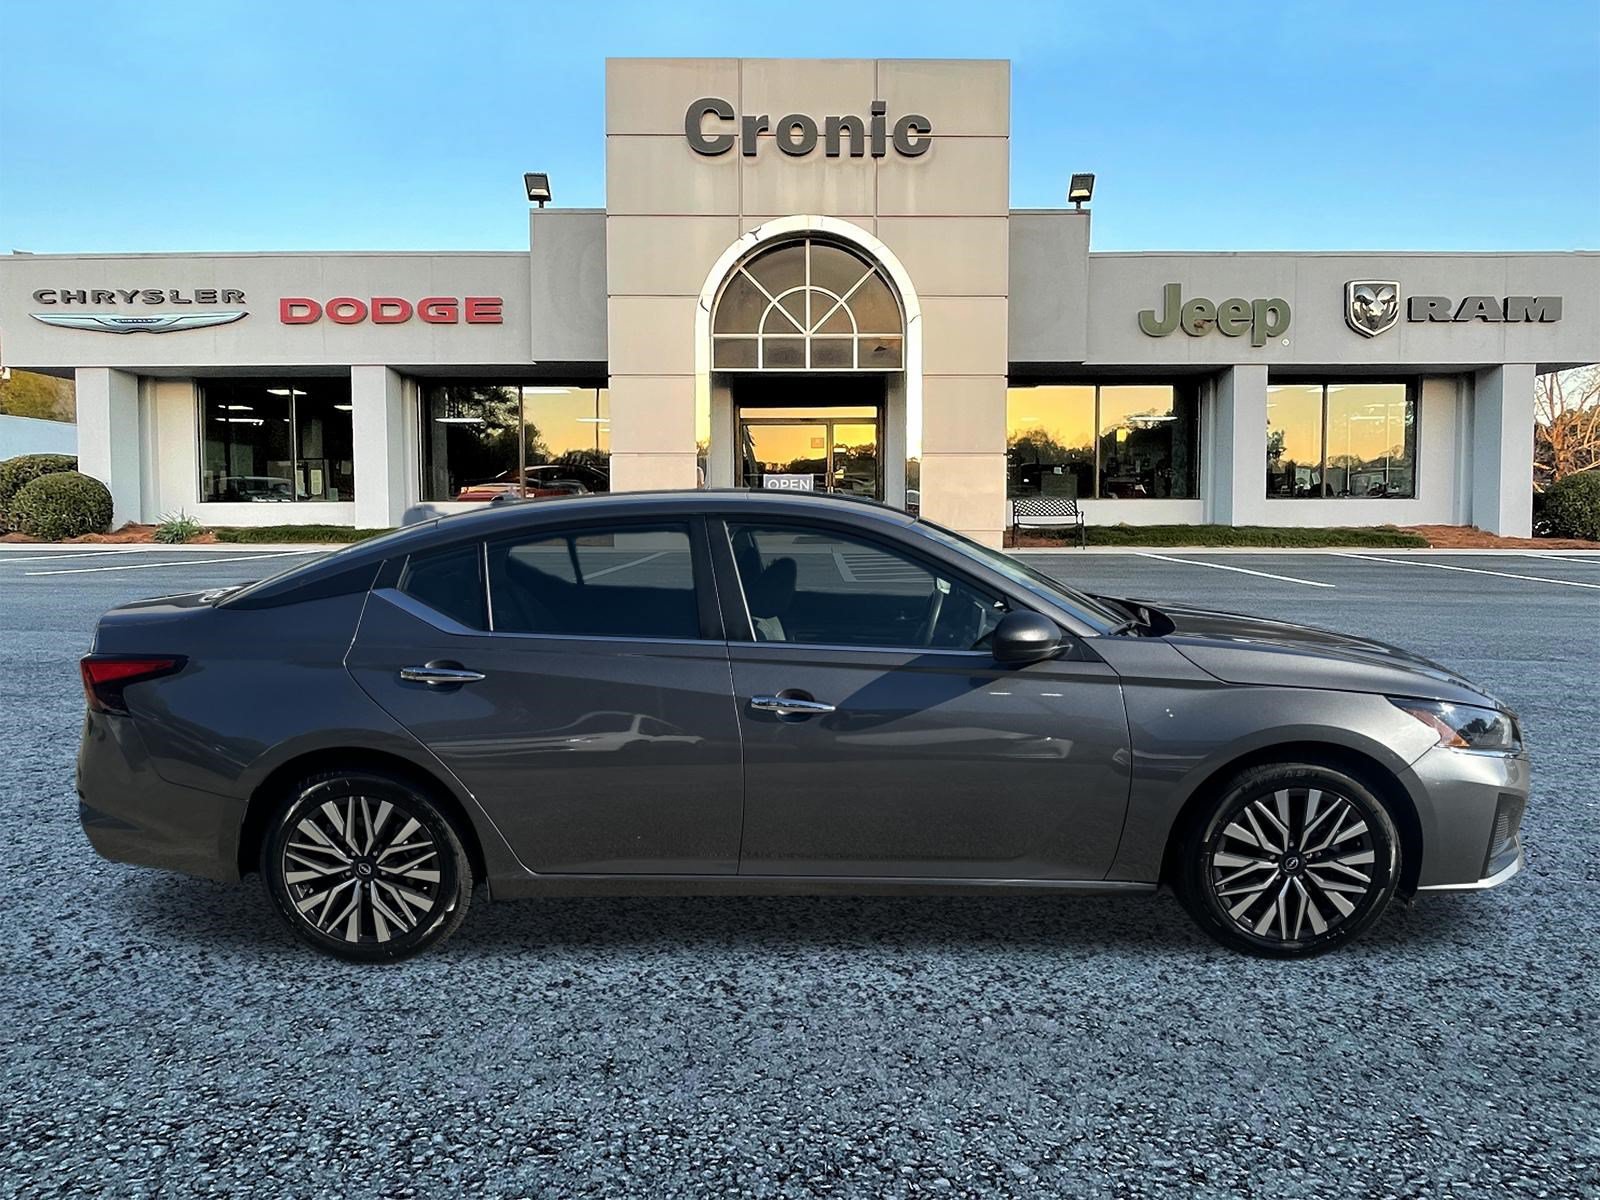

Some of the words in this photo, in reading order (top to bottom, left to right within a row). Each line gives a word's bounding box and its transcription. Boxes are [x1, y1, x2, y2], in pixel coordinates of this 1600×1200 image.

[685, 97, 932, 157] Cronic
[33, 289, 246, 305] CHRYSLER
[1407, 296, 1562, 322] RAM
[279, 297, 503, 324] DODGE
[1138, 282, 1291, 347] Jeep
[767, 479, 810, 490] OPEN
